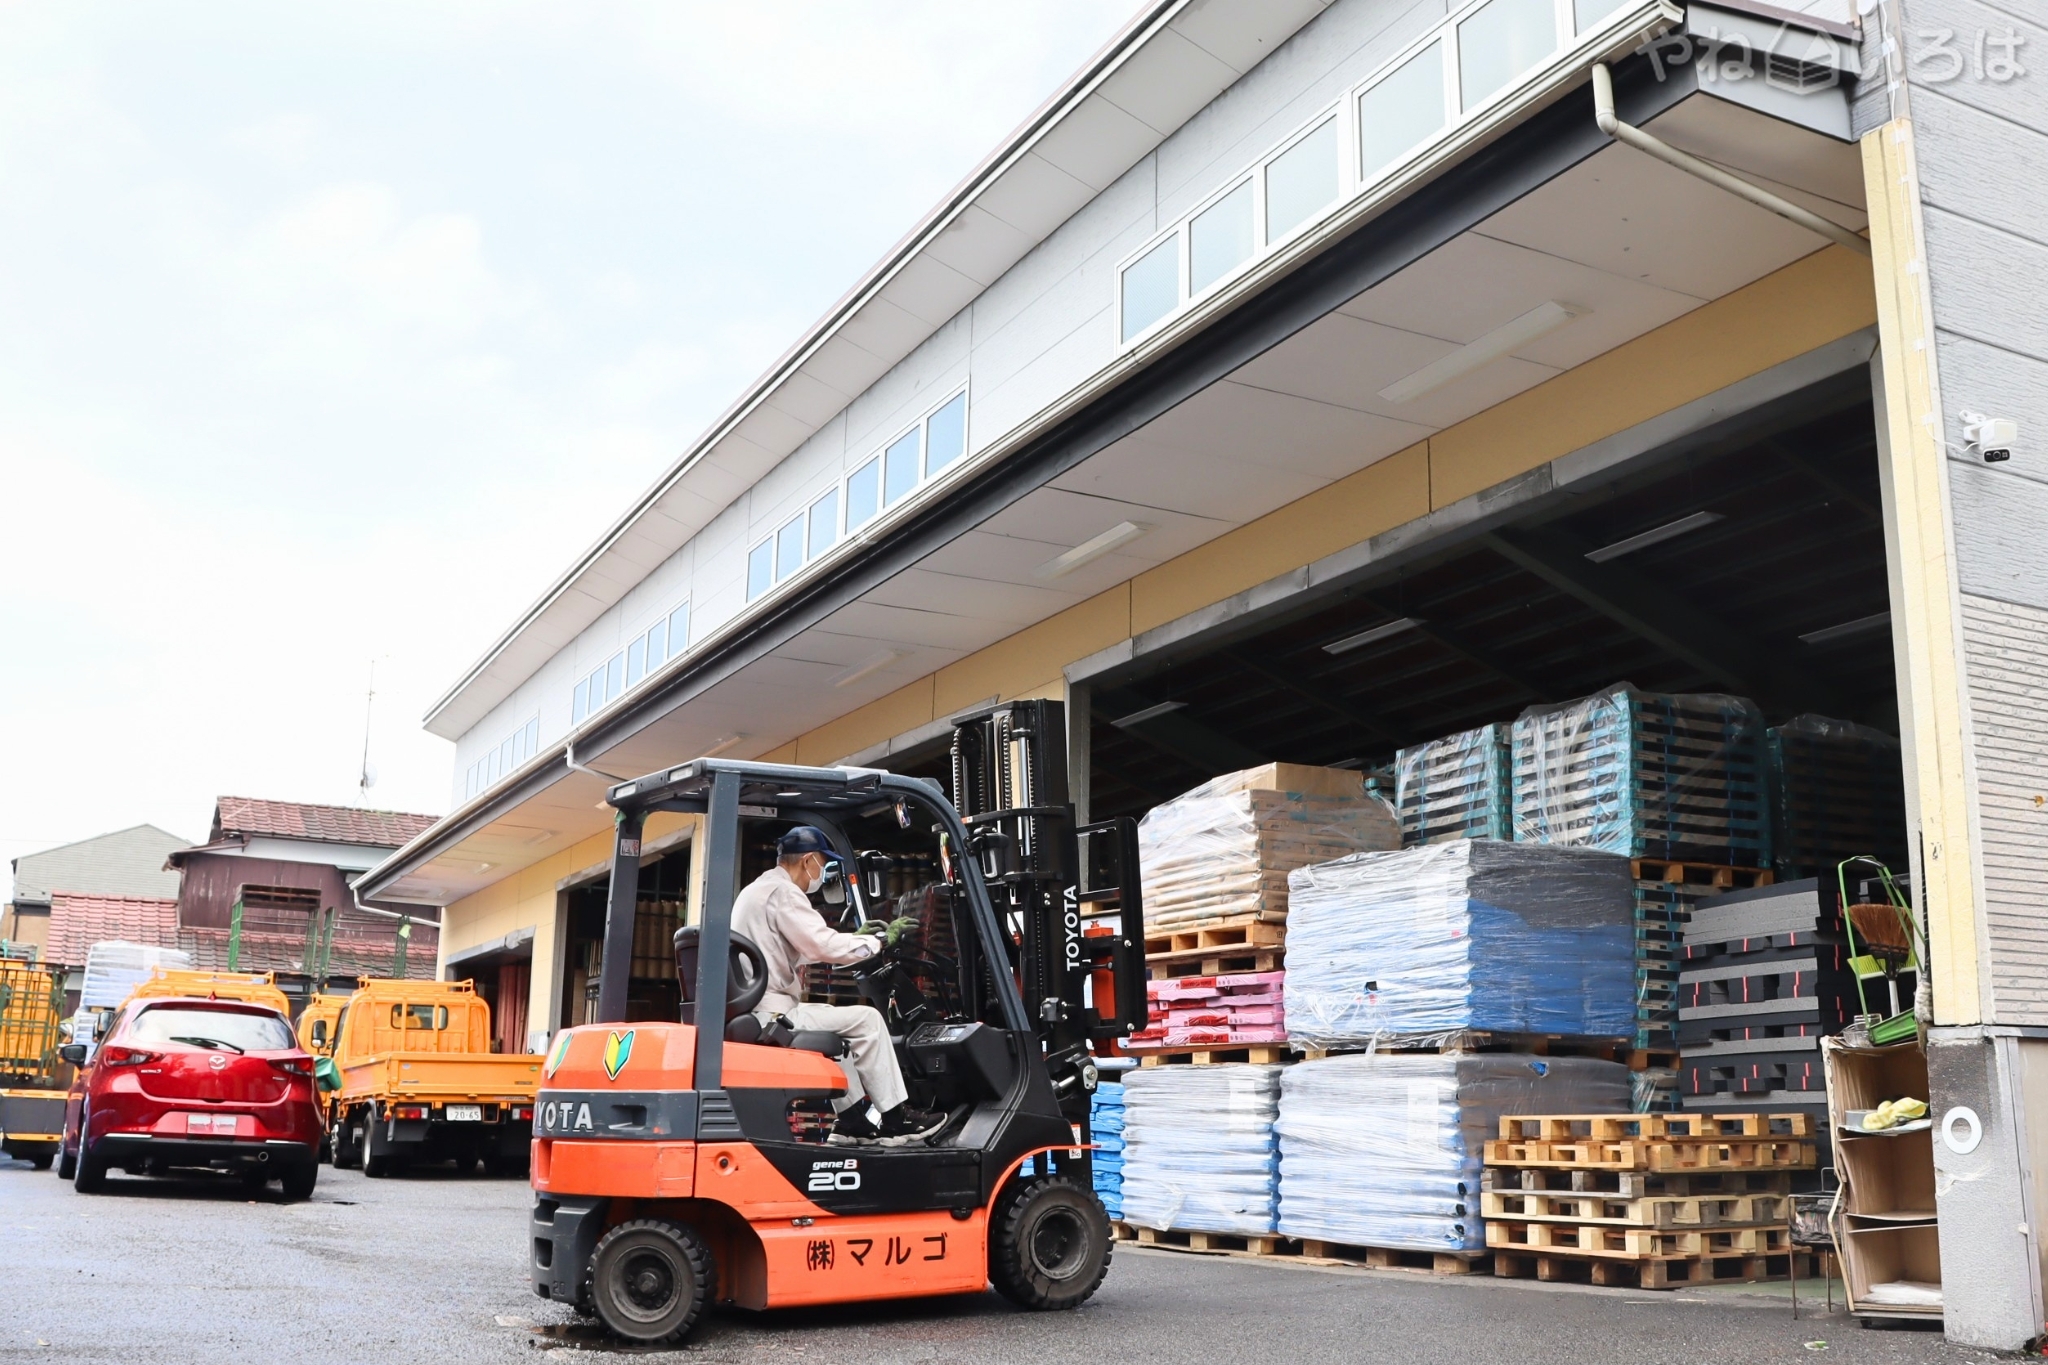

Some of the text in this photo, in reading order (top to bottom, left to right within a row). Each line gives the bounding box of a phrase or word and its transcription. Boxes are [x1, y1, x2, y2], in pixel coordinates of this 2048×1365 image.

[1063, 885, 1080, 972] TOYOTA
[533, 1101, 594, 1131] YOTA
[808, 1171, 861, 1192] 20
